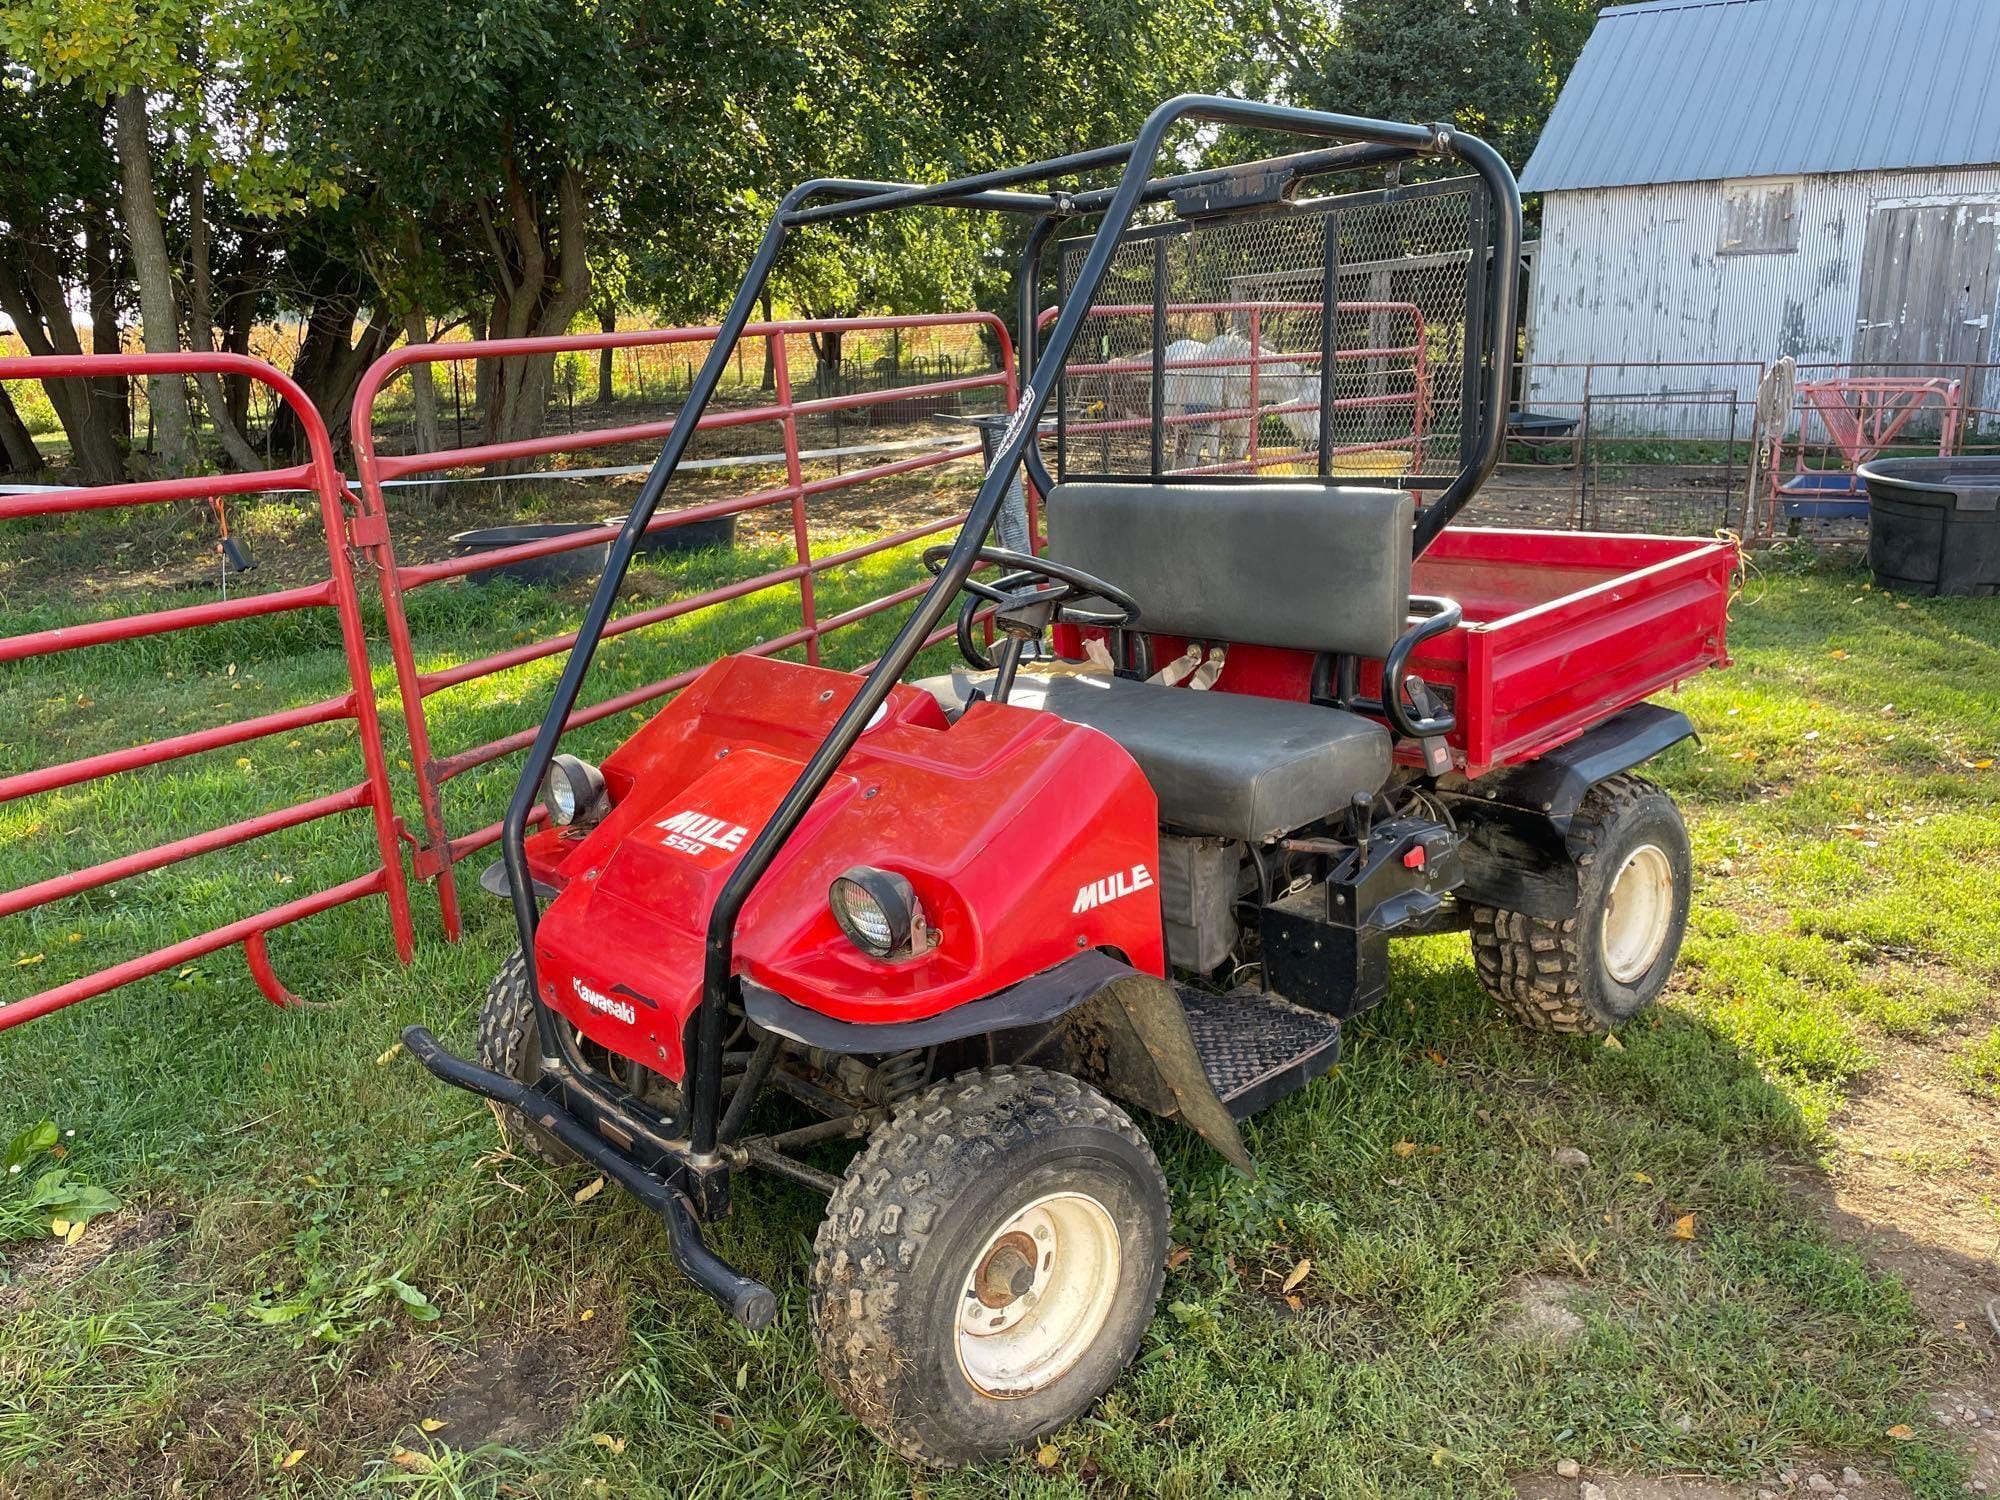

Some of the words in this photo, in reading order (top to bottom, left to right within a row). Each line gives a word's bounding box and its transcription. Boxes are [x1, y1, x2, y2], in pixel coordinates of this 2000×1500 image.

[655, 810, 749, 853] MULE
[661, 833, 707, 855] 550
[1072, 864, 1154, 914] MULE
[573, 977, 635, 1025] Kawasaki
